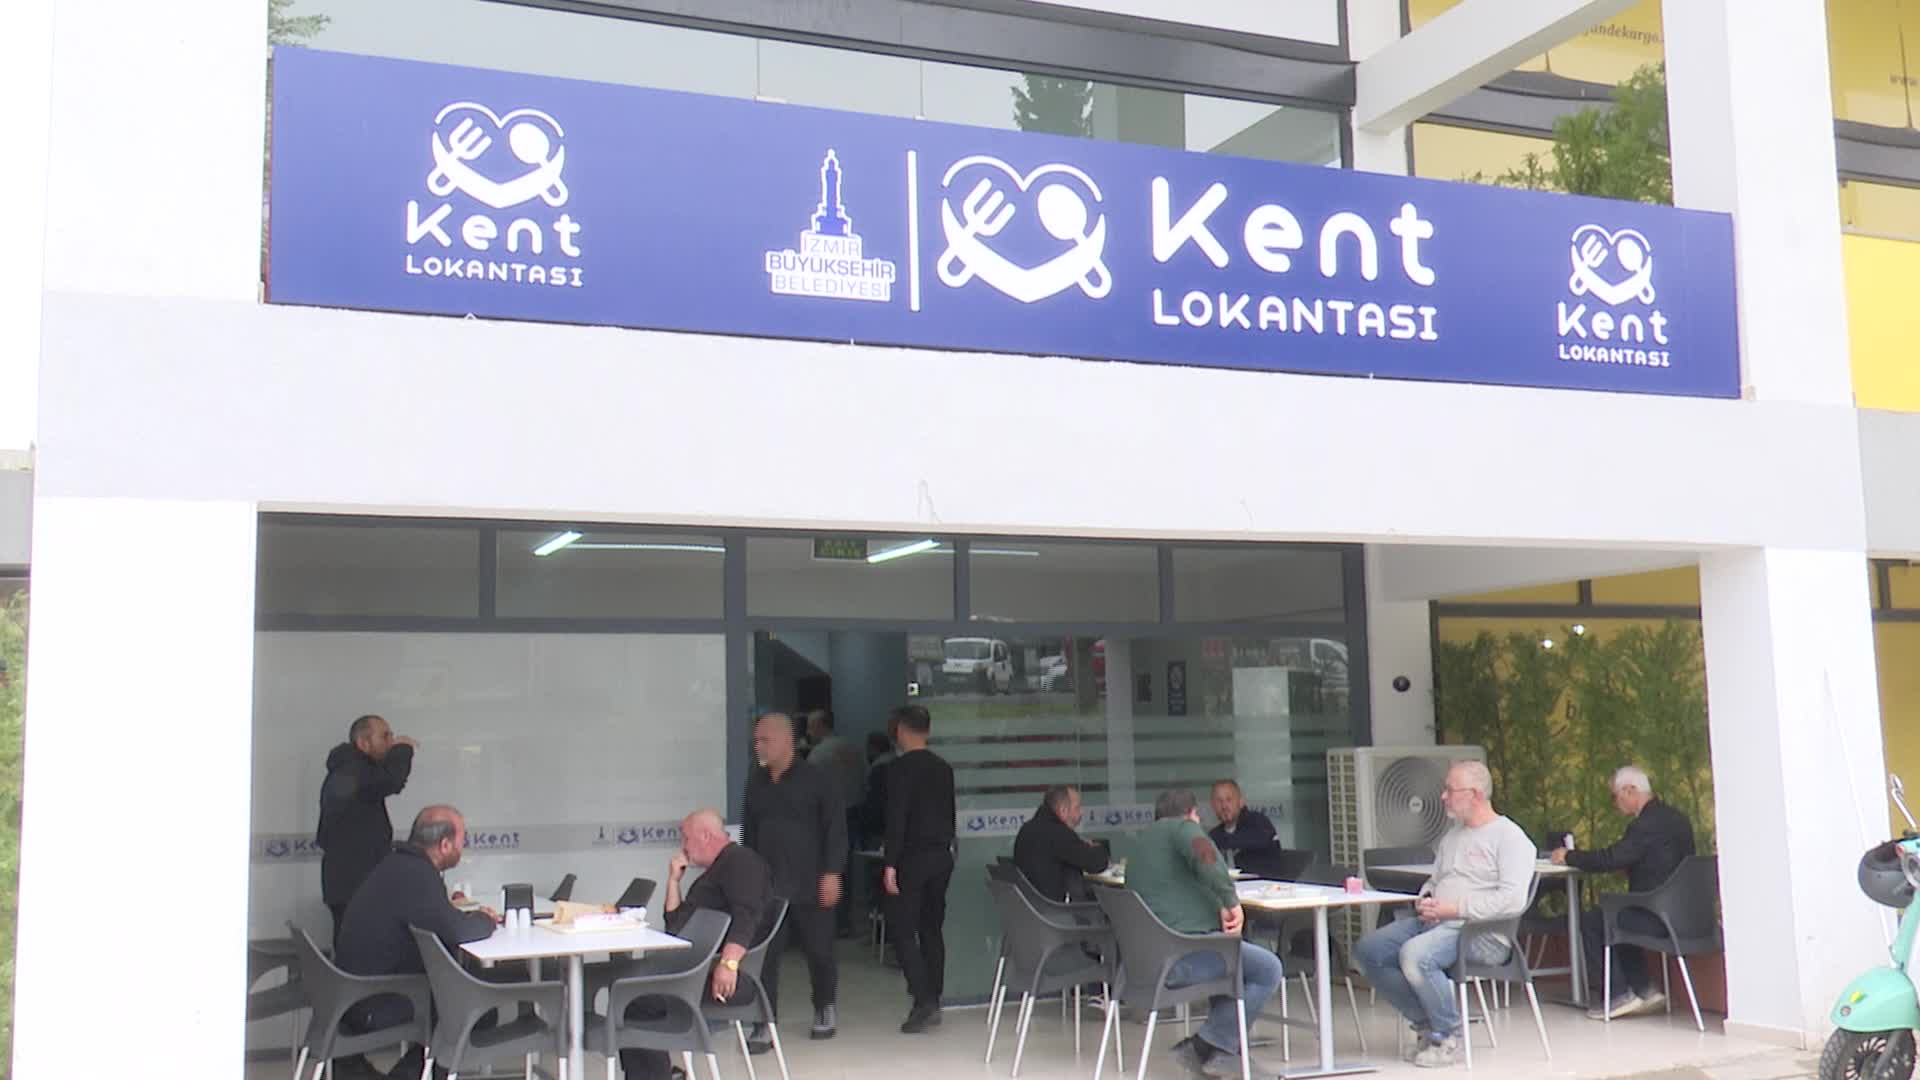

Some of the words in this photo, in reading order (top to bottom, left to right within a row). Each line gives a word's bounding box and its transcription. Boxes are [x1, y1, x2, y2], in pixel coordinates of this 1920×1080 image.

[406, 200, 581, 257] Kent
[1152, 176, 1435, 286] Kent
[406, 254, 583, 287] LOKANTASI
[1153, 288, 1438, 341] LOKANTASI
[1557, 301, 1668, 345] Kent
[1559, 343, 1670, 368] LOKANTASI
[474, 832, 519, 846] Kent
